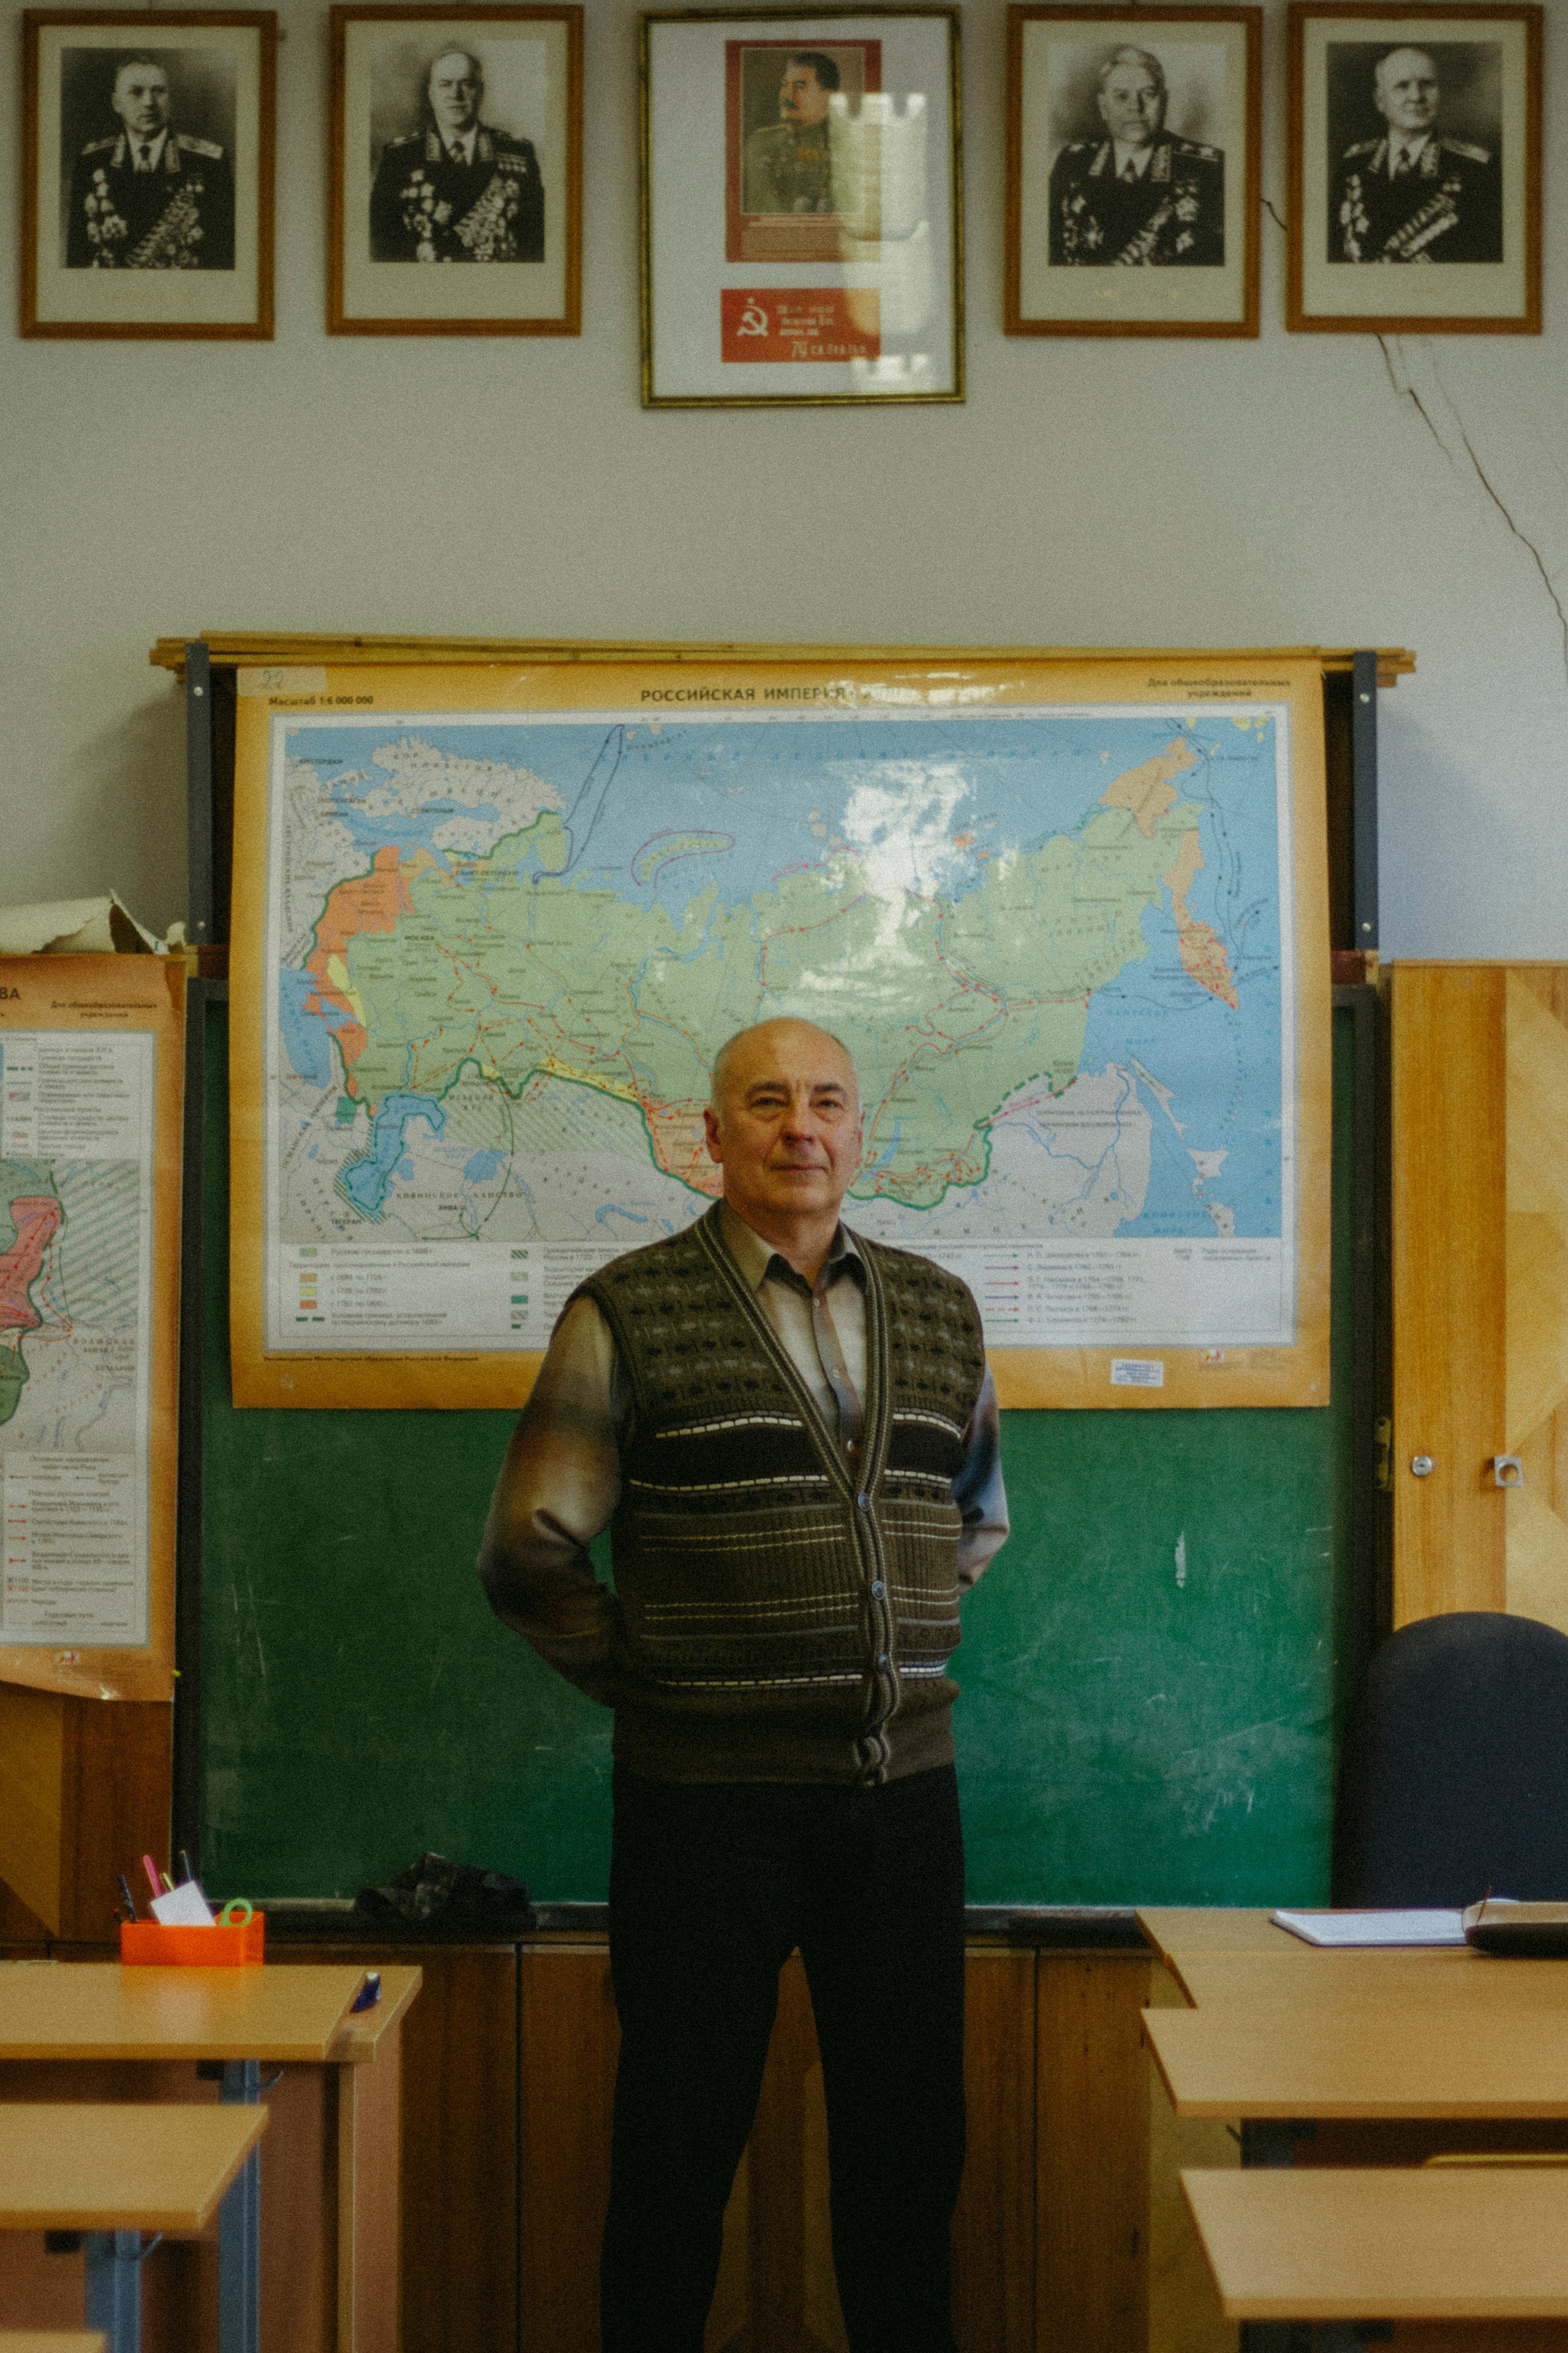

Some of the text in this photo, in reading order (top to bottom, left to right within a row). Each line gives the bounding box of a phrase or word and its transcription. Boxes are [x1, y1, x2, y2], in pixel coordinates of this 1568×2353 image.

[1148, 678, 1167, 687] Для
[641, 686, 755, 701] РОССИЙСКАЯ
[268, 695, 374, 706] Масштаб 1:6 000 000
